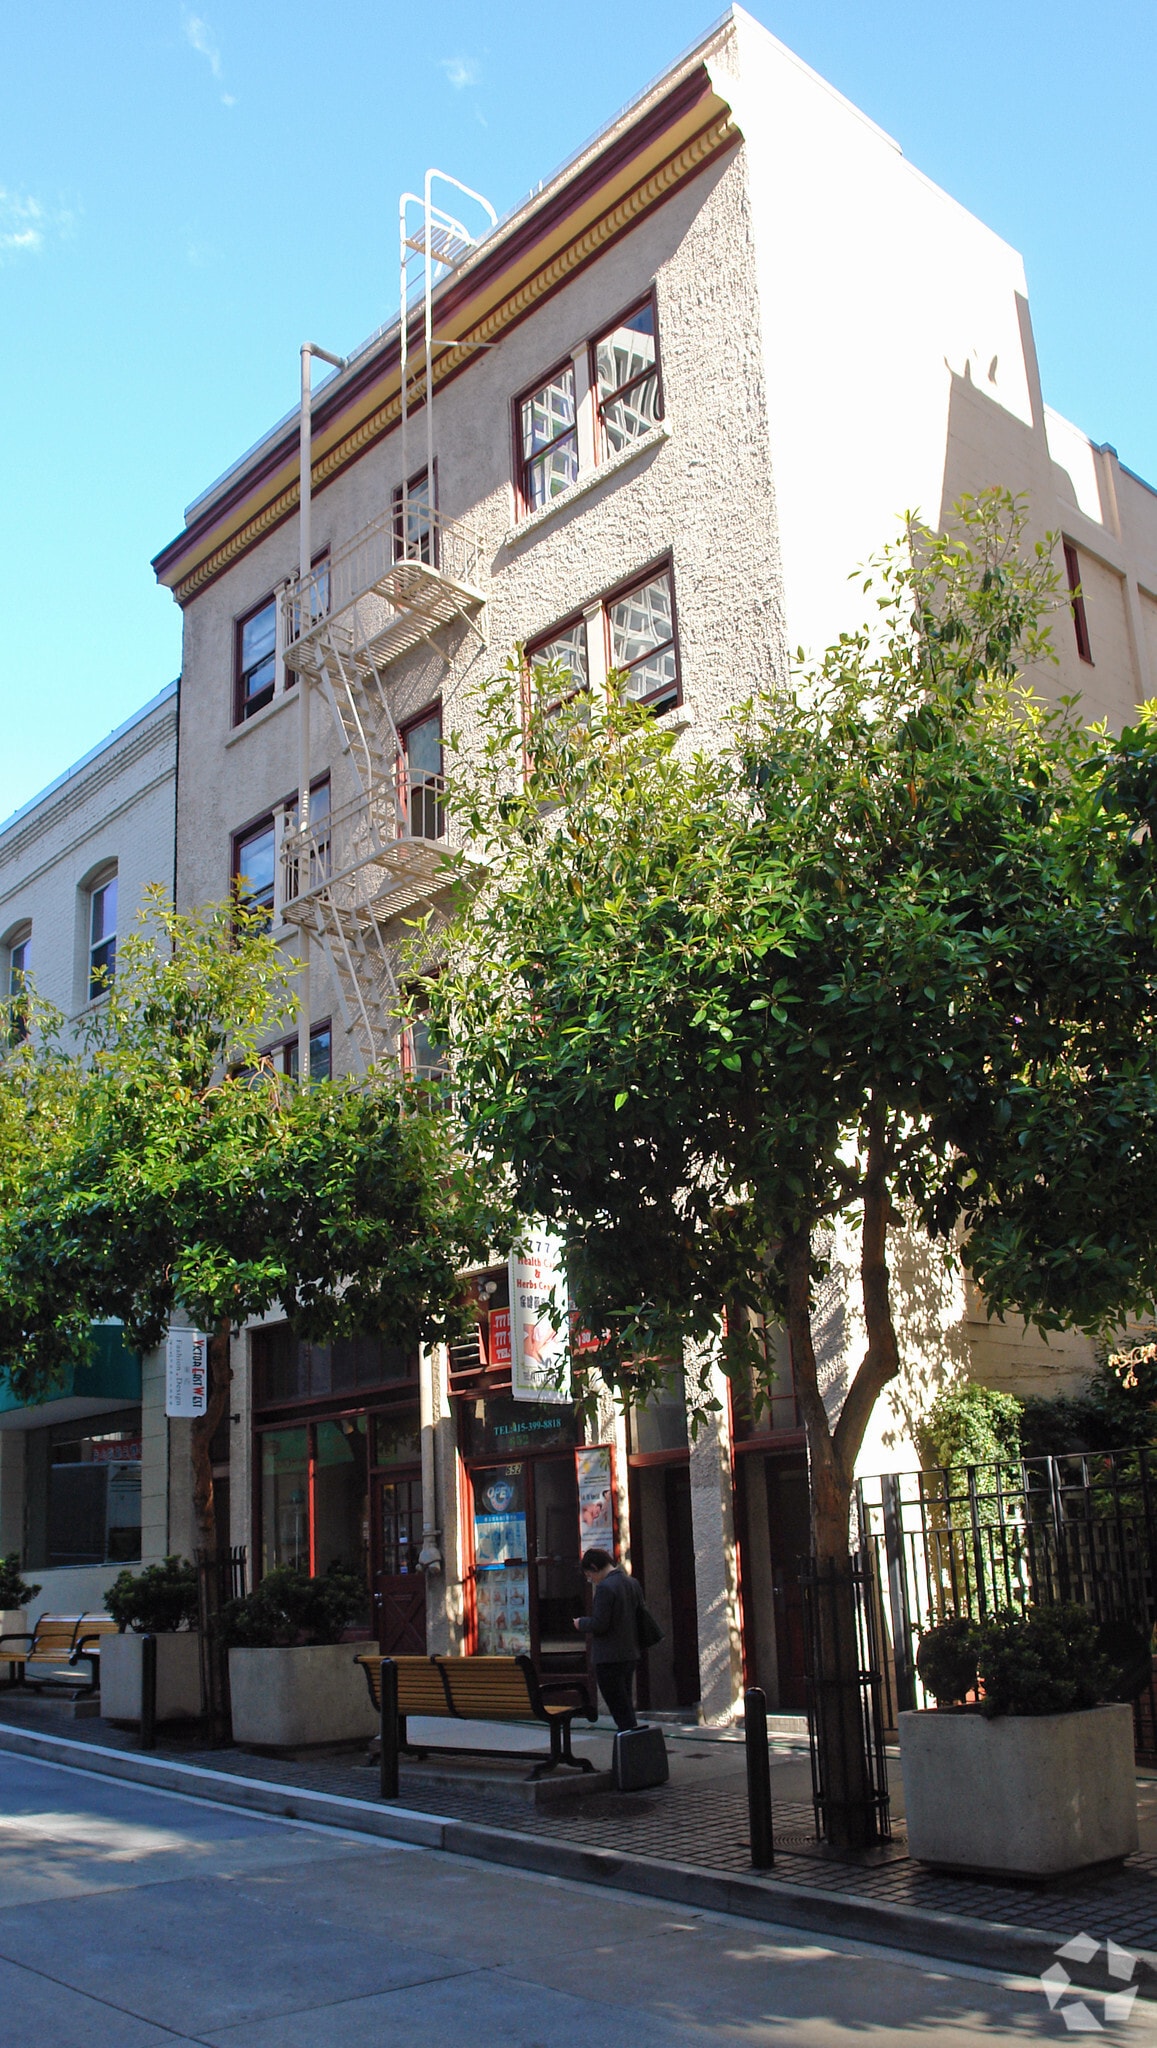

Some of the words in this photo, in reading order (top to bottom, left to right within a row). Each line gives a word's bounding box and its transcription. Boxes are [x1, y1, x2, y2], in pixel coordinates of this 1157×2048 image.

[534, 1268, 541, 1279] &
[516, 1278, 537, 1290] Herbs
[487, 1486, 514, 1499] OPEN
